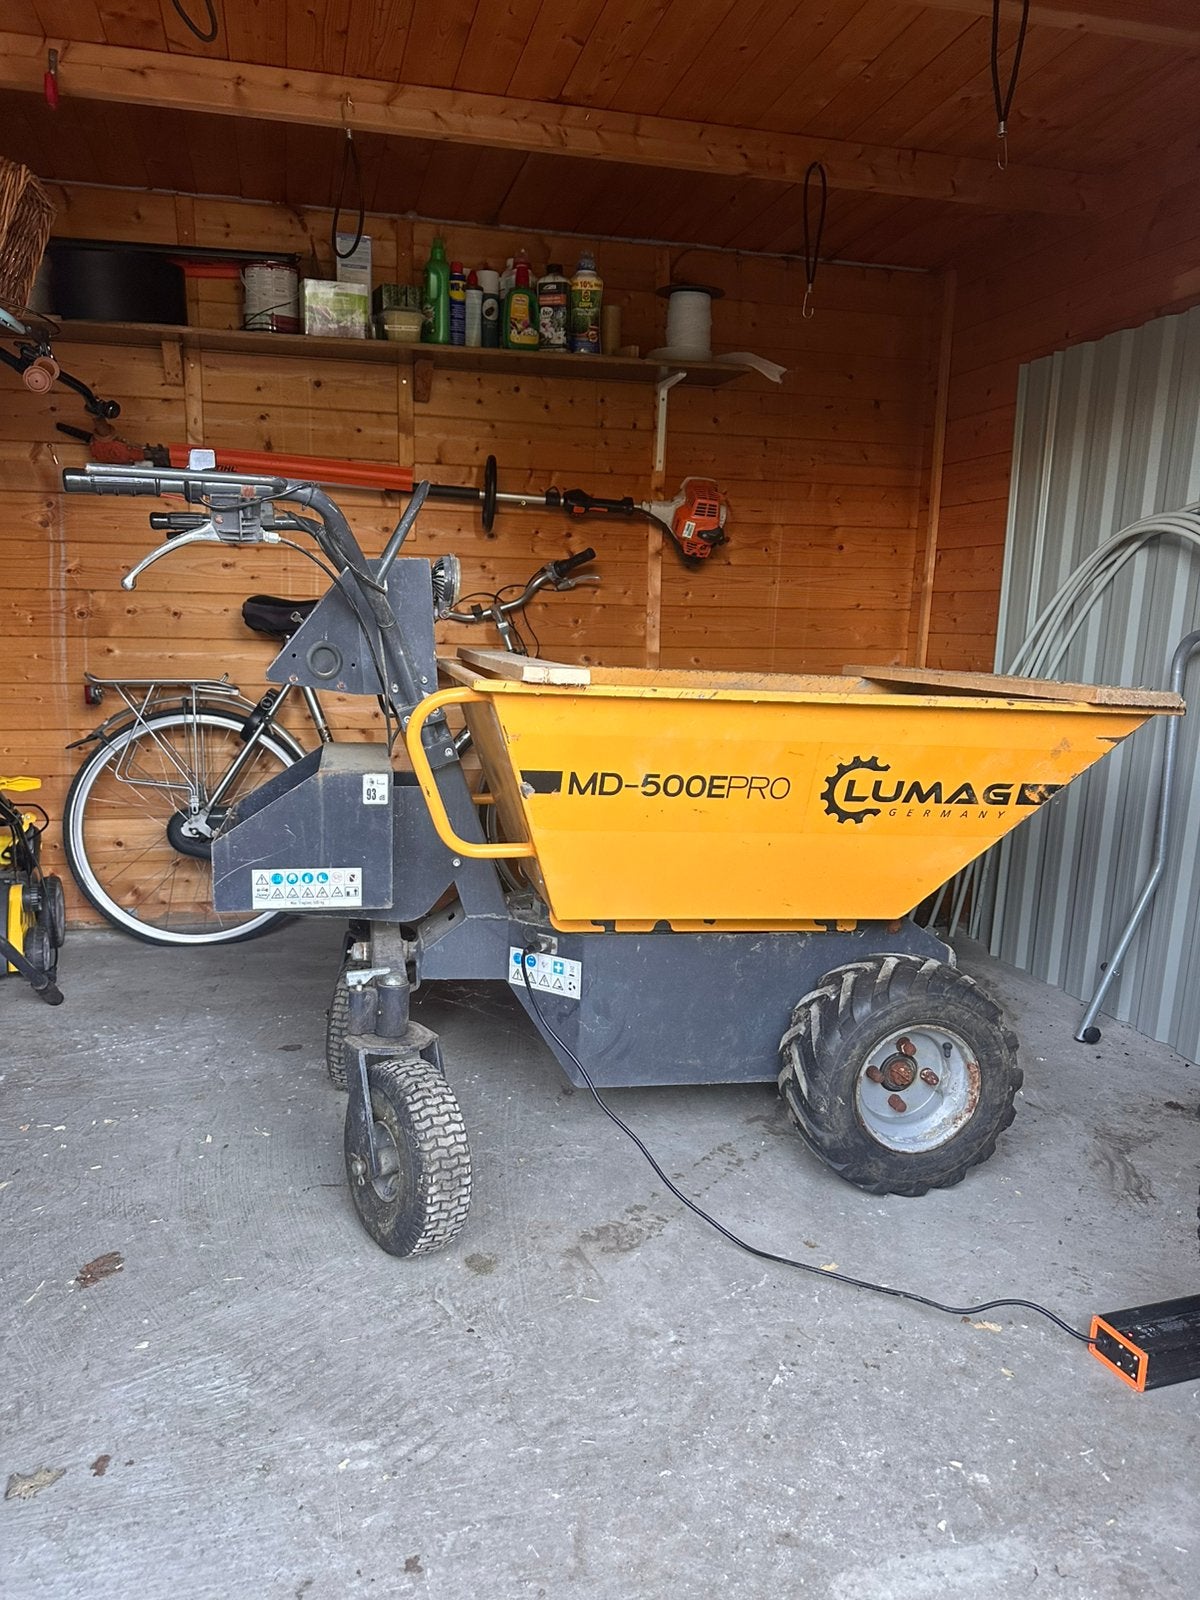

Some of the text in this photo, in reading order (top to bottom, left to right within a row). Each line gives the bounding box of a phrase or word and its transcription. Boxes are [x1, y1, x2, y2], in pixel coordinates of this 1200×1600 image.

[366, 787, 377, 801] 93
[567, 771, 791, 800] MD-500EPRO
[843, 779, 1015, 806] LUMAG
[888, 808, 1006, 819] GERMANY
